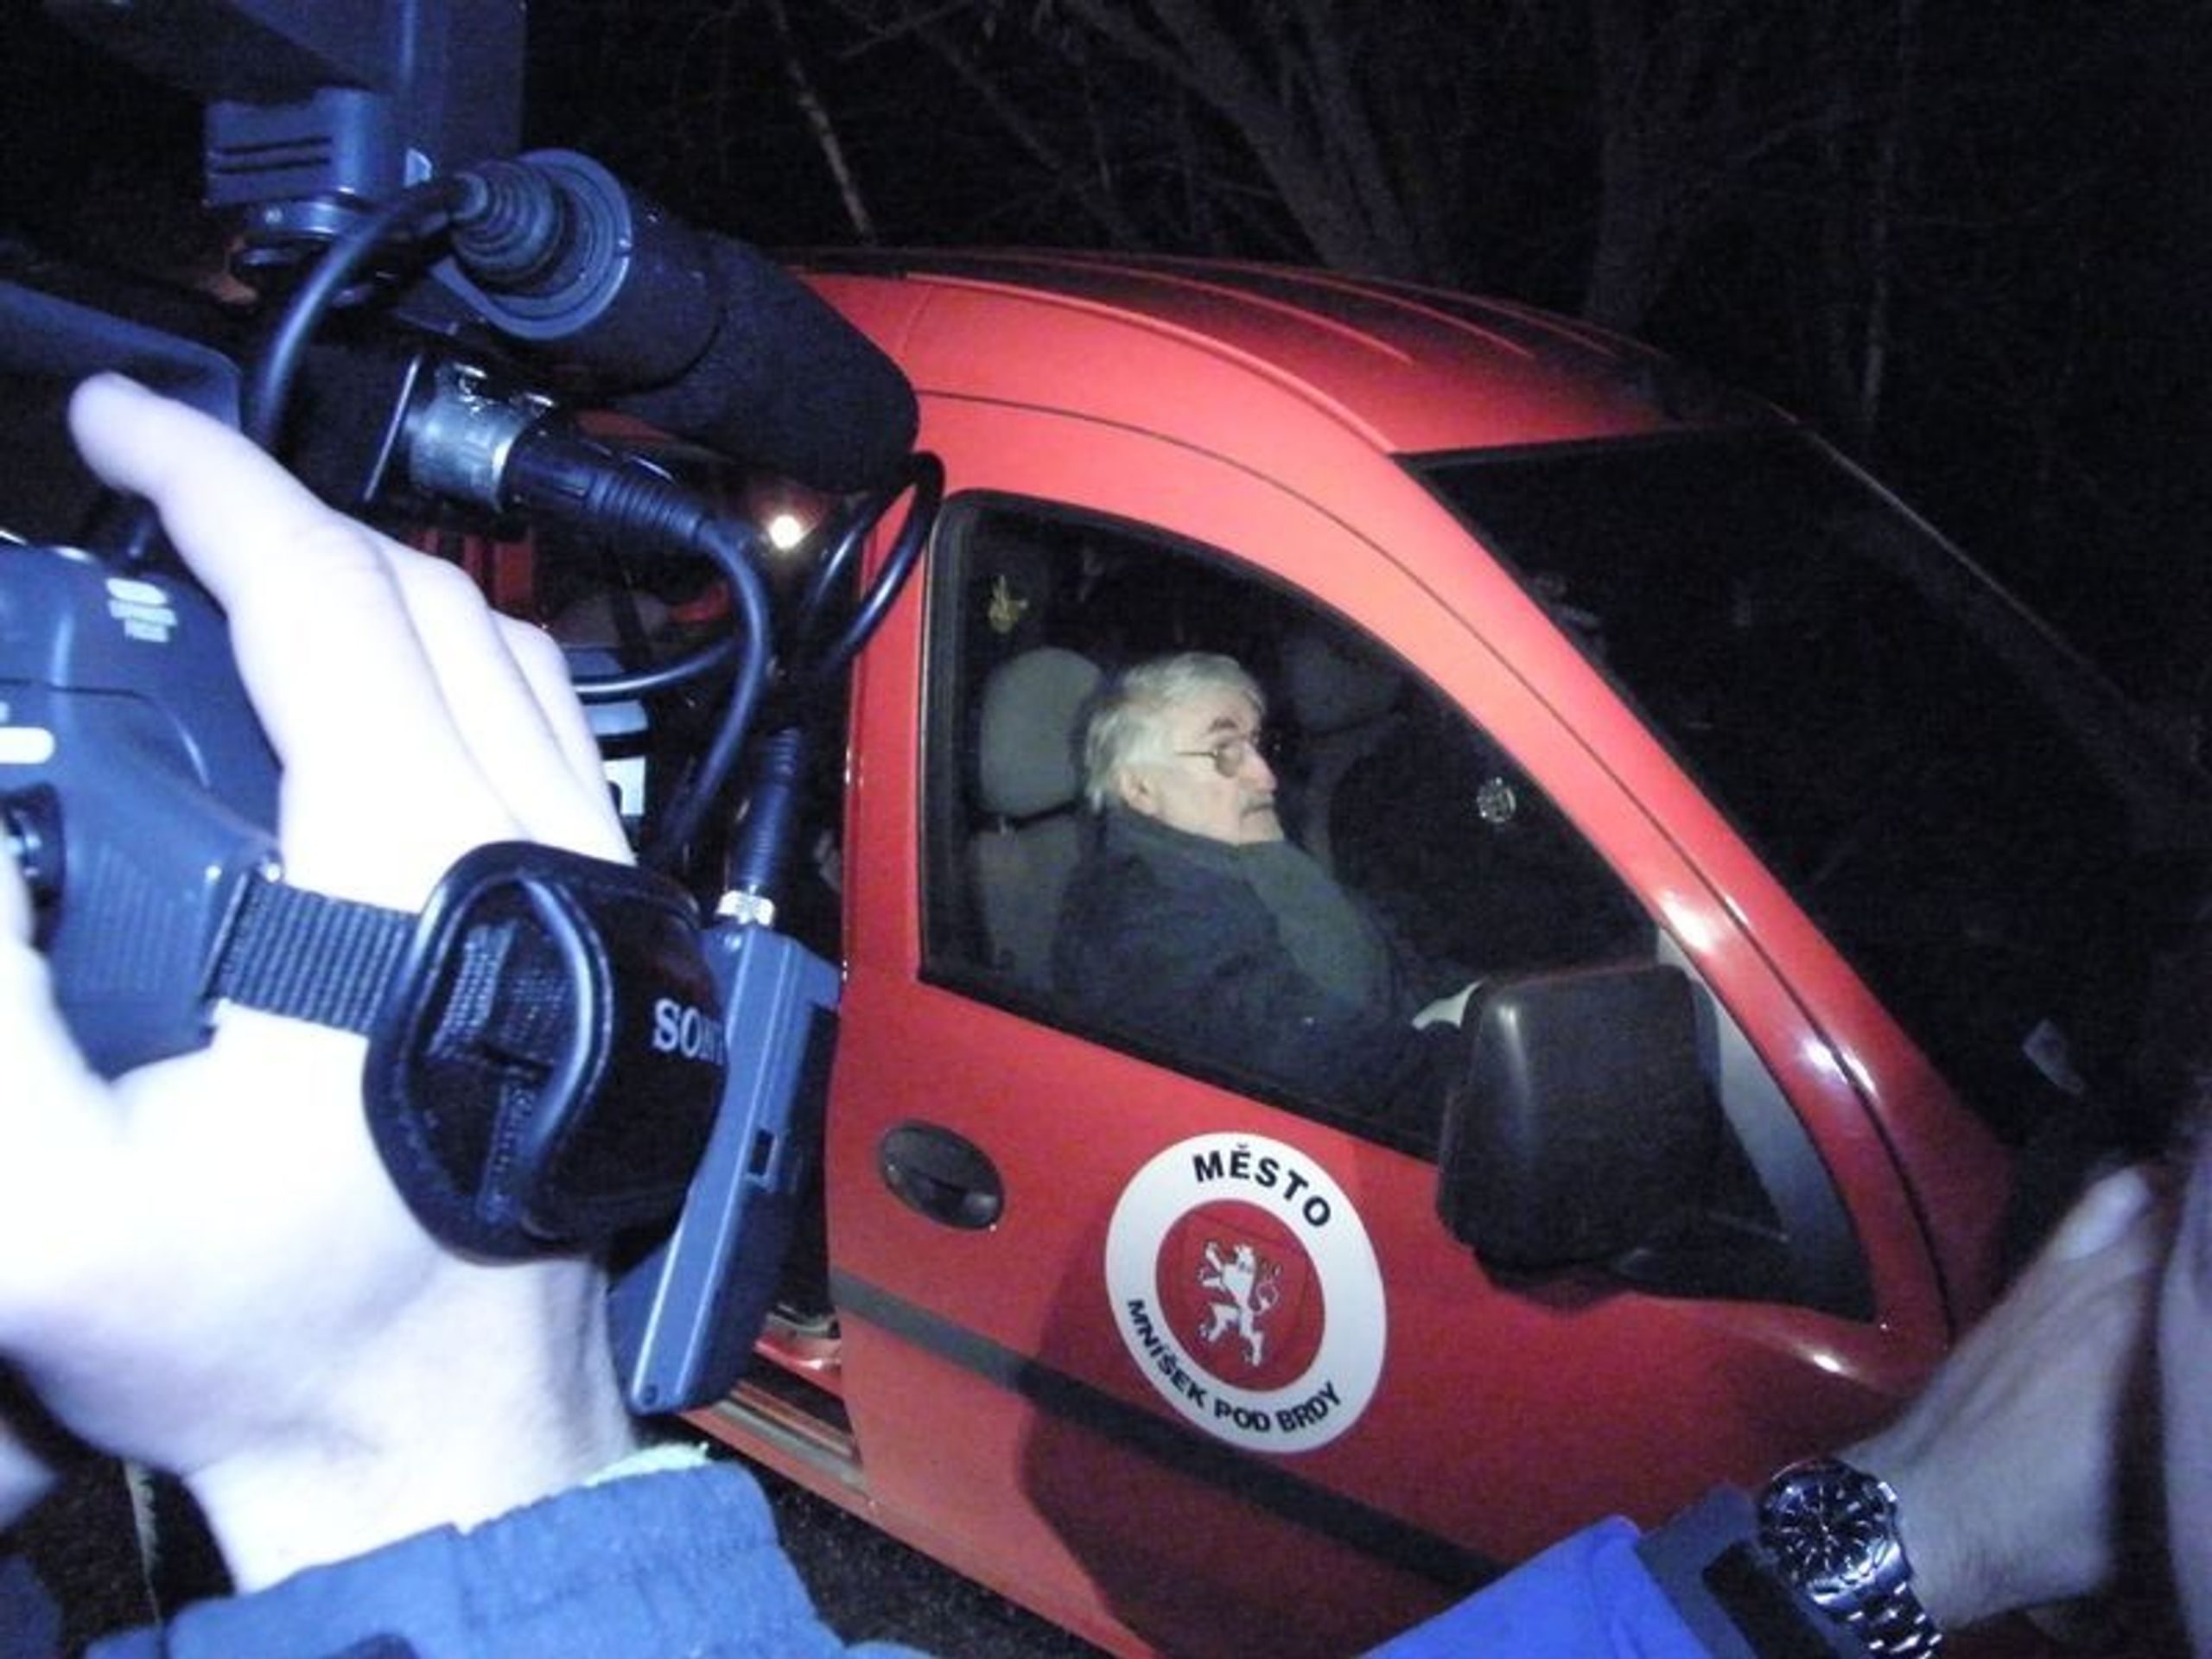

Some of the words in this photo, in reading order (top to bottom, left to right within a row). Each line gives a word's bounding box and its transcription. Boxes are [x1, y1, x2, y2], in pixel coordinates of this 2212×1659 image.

[1193, 1142, 1332, 1228] MĚSTO
[1128, 1299, 1207, 1408] MNÍŠEK
[1214, 1398, 1271, 1433] POD
[1276, 1379, 1342, 1433] BRDY
